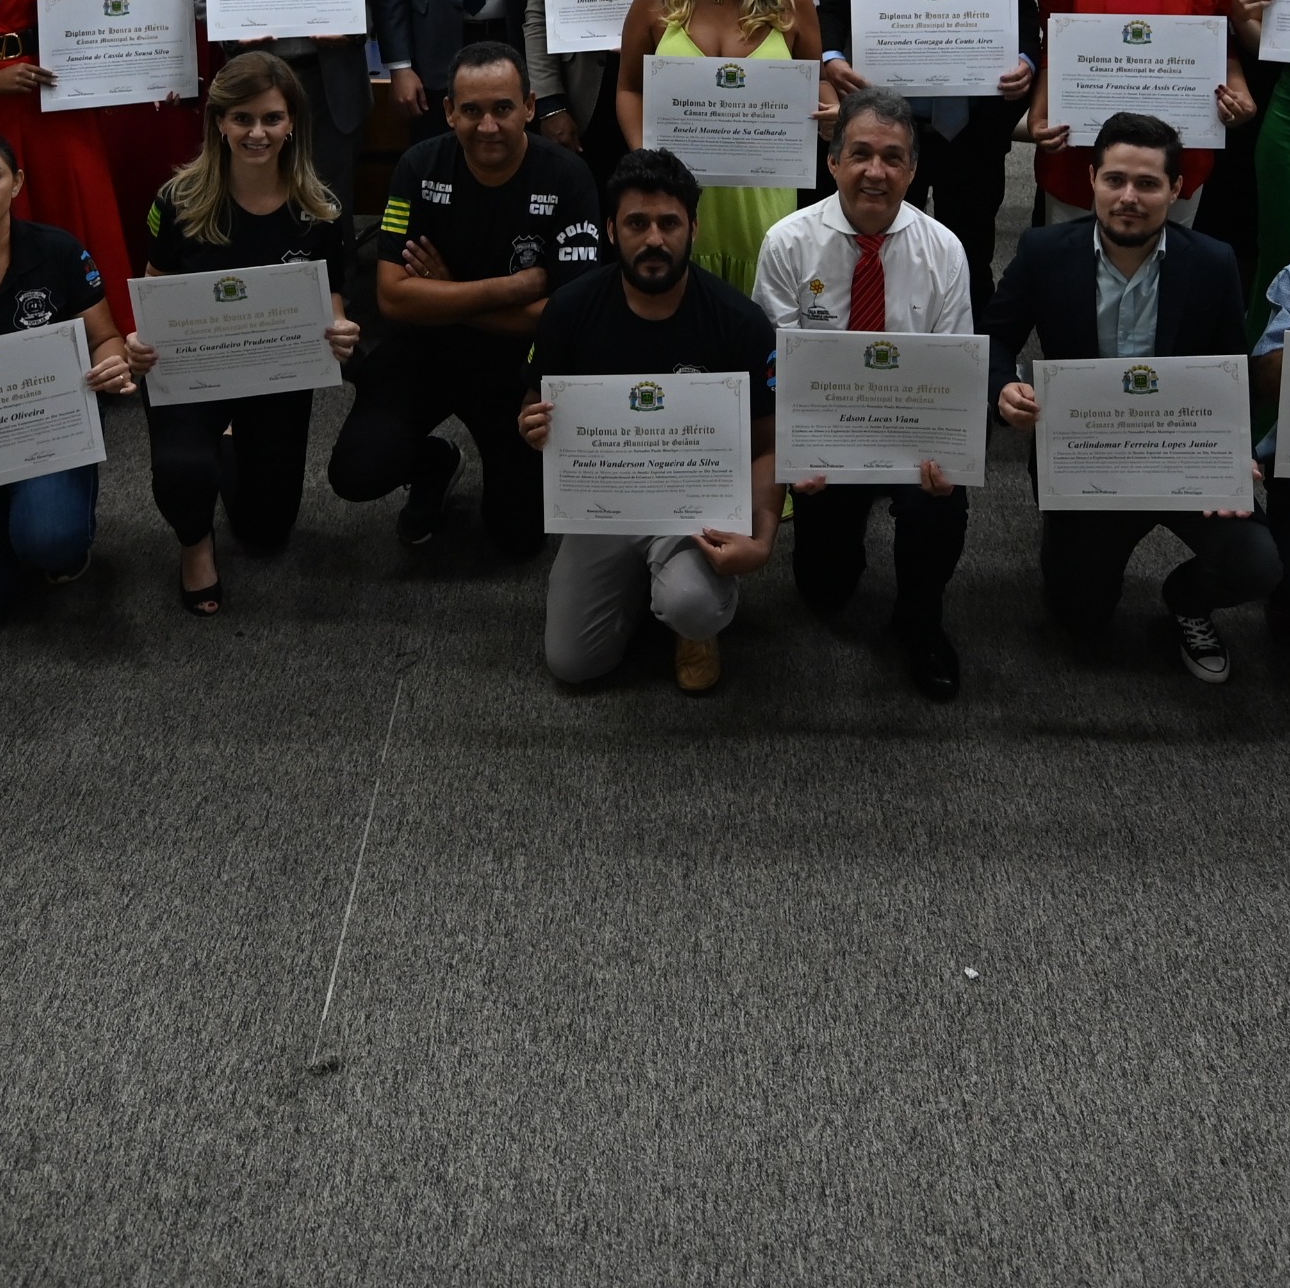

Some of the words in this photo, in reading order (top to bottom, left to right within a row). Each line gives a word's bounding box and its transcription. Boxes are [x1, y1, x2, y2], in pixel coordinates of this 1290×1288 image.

[877, 38, 913, 46] Marcondes
[914, 38, 944, 47] Gonzaga
[954, 37, 975, 45] Couto
[1076, 82, 1104, 90] Vanessa
[1105, 82, 1141, 91] Francisca
[1141, 83, 1151, 91] de
[1171, 84, 1197, 92] Cerino
[673, 126, 698, 134] Roselei
[698, 127, 732, 135] Monteiro
[753, 128, 787, 136] Galhardo
[422, 190, 451, 204] CIVIL
[175, 346, 197, 355] Erika
[199, 341, 242, 352] Guardieiro
[243, 337, 279, 347] Prudente
[279, 334, 302, 342] Costa
[10, 408, 45, 422] Oliveira
[839, 414, 866, 423] Edson
[867, 414, 893, 423] Lucas
[895, 415, 920, 424] Viana
[1069, 409, 1112, 420] Diploma
[1114, 409, 1125, 418] de
[1128, 408, 1161, 418] Honra
[1177, 407, 1213, 418] Mérito
[576, 426, 618, 438] Diploma
[620, 427, 632, 436] de
[634, 426, 666, 437] Honra
[668, 428, 679, 436] ao
[681, 425, 716, 436] Mérito
[591, 439, 621, 448] Câmara
[622, 439, 660, 448] Municipal
[661, 439, 670, 447] de
[671, 437, 700, 447] Goiânia
[1067, 440, 1122, 449] Carlindomar
[1123, 440, 1160, 449] Ferreira
[1161, 440, 1187, 451] Lopes
[1188, 439, 1219, 449] Junior
[572, 459, 597, 468] Paulo
[599, 460, 646, 468] Wanderson
[647, 459, 685, 469] Nogueira
[686, 458, 698, 467] da
[698, 458, 720, 467] Silva
